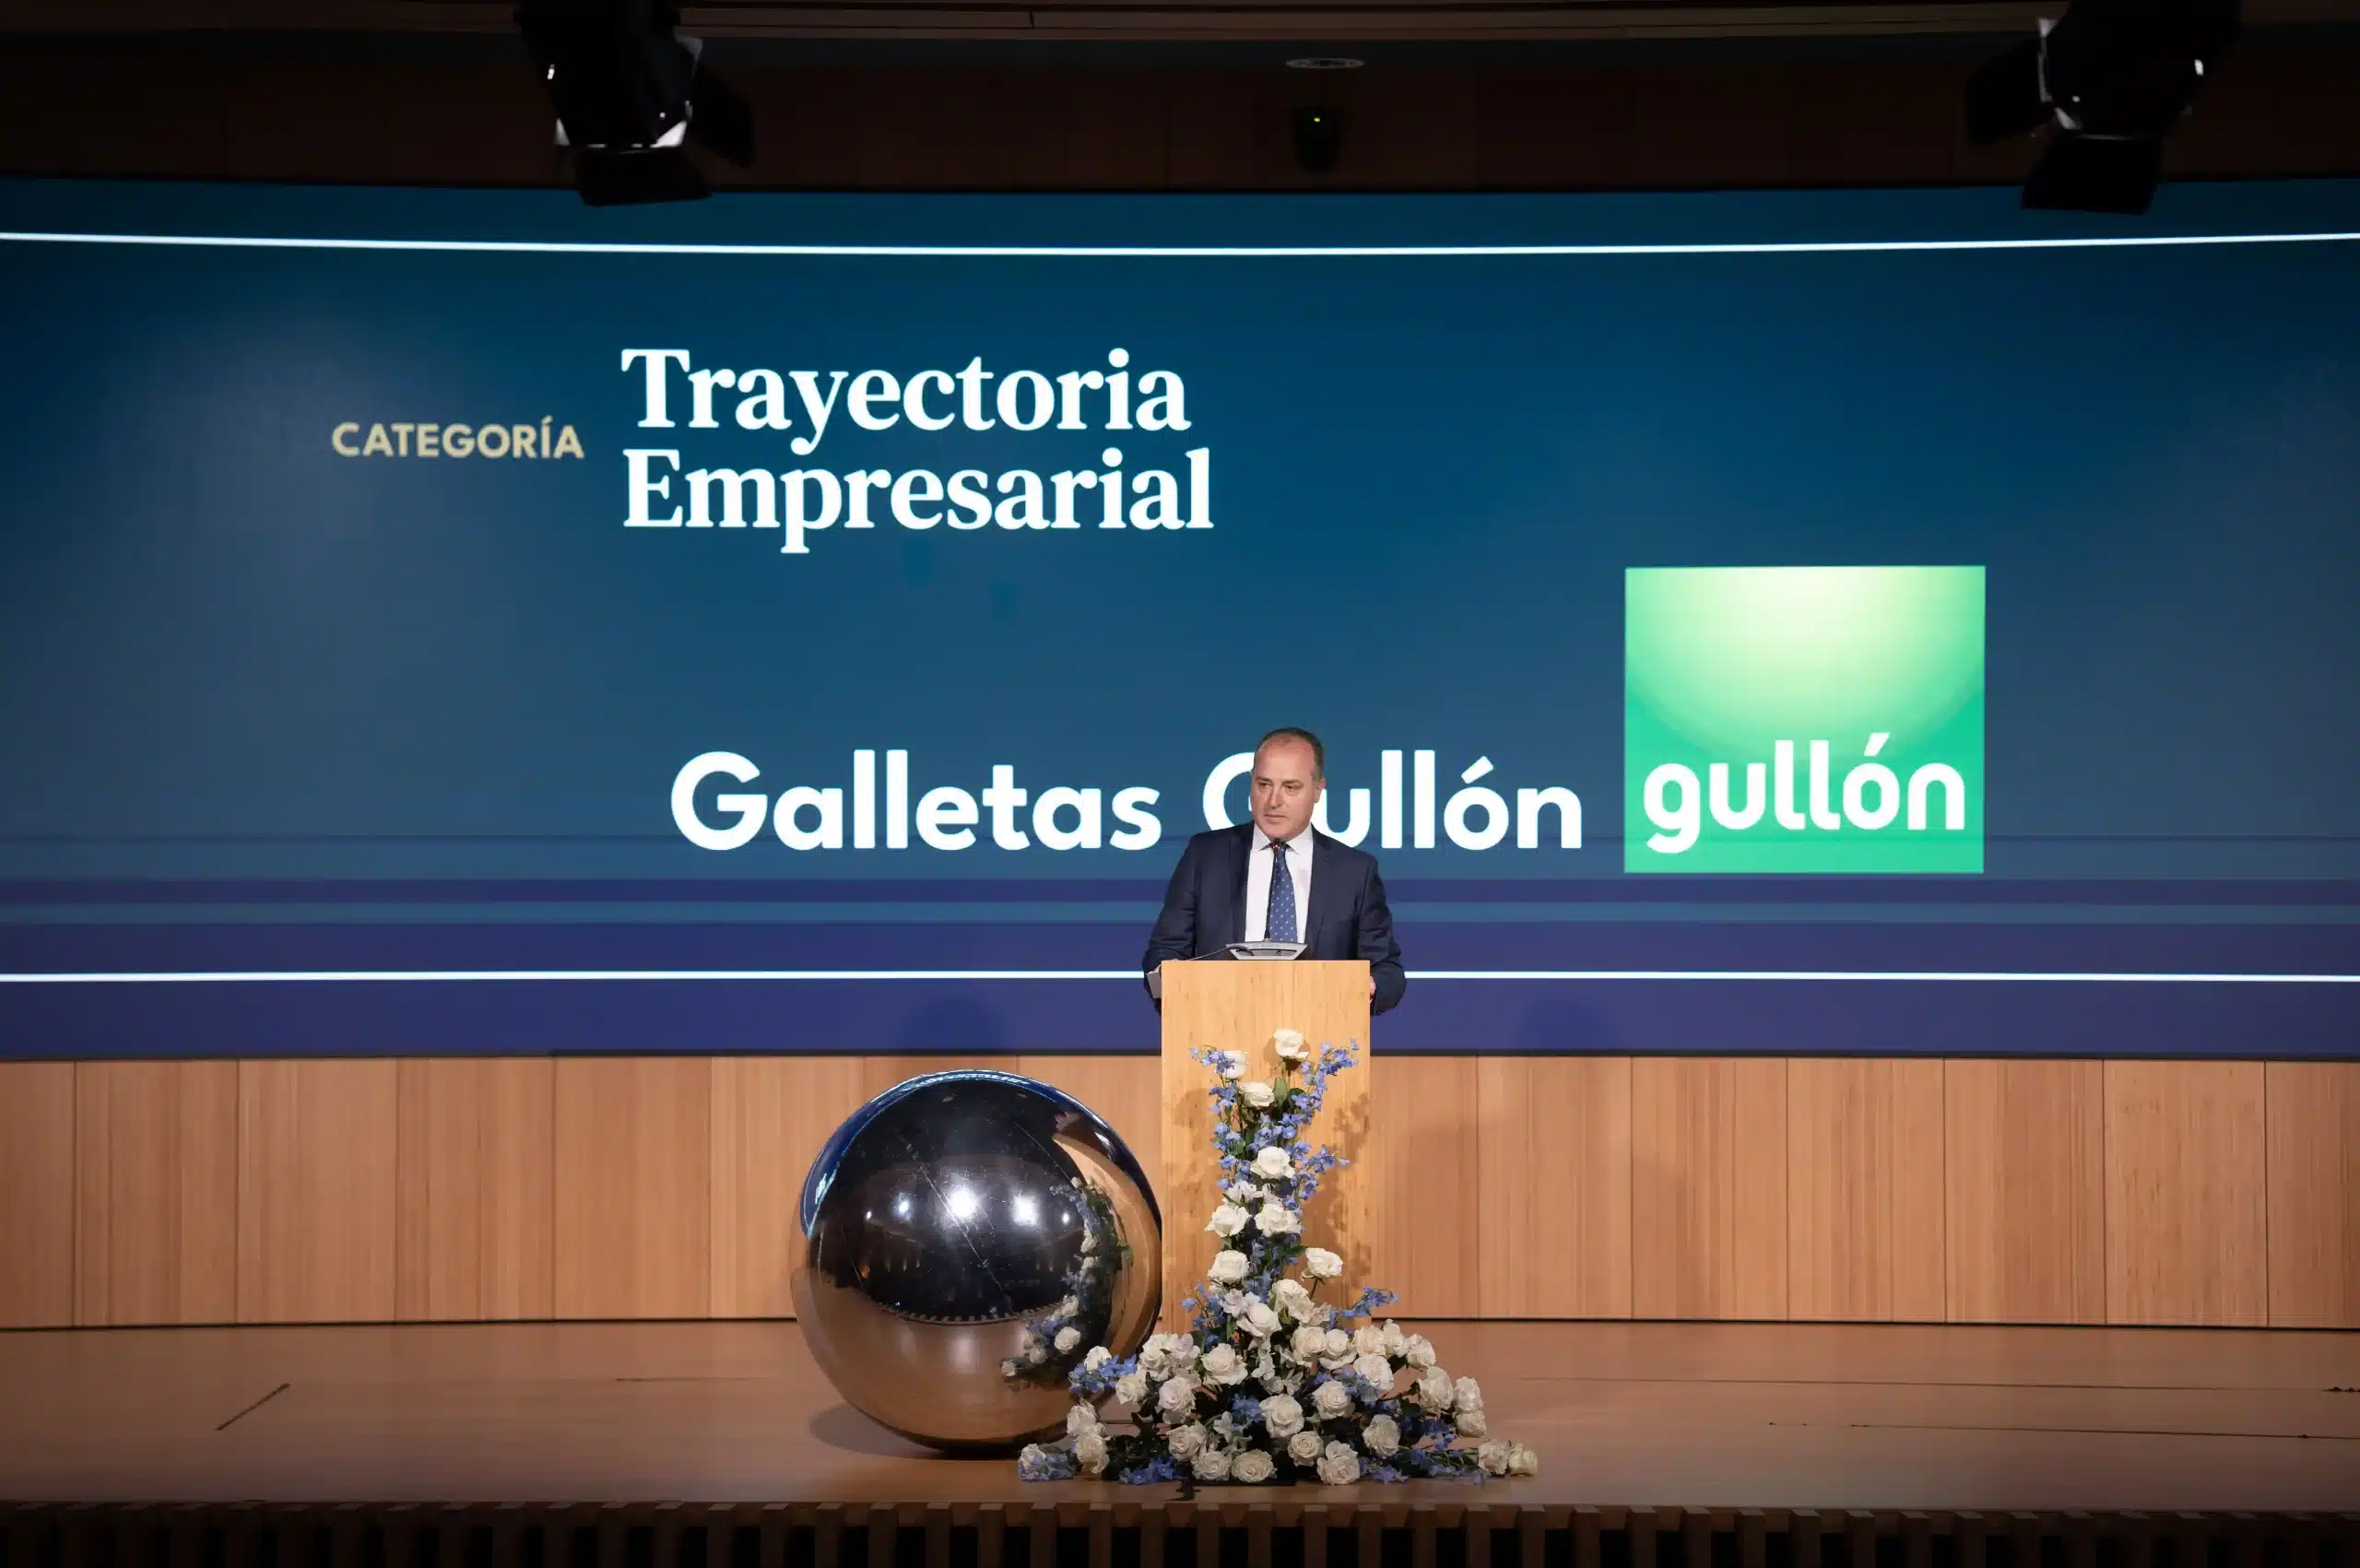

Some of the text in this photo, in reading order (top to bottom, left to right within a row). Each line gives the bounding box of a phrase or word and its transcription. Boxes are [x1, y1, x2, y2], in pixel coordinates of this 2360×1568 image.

[331, 415, 585, 459] CATEGORÍA
[621, 348, 1192, 455] Trayectoria
[623, 447, 1214, 554] Empresarial
[671, 749, 1162, 851] Galletas
[1644, 733, 1965, 854] gullón
